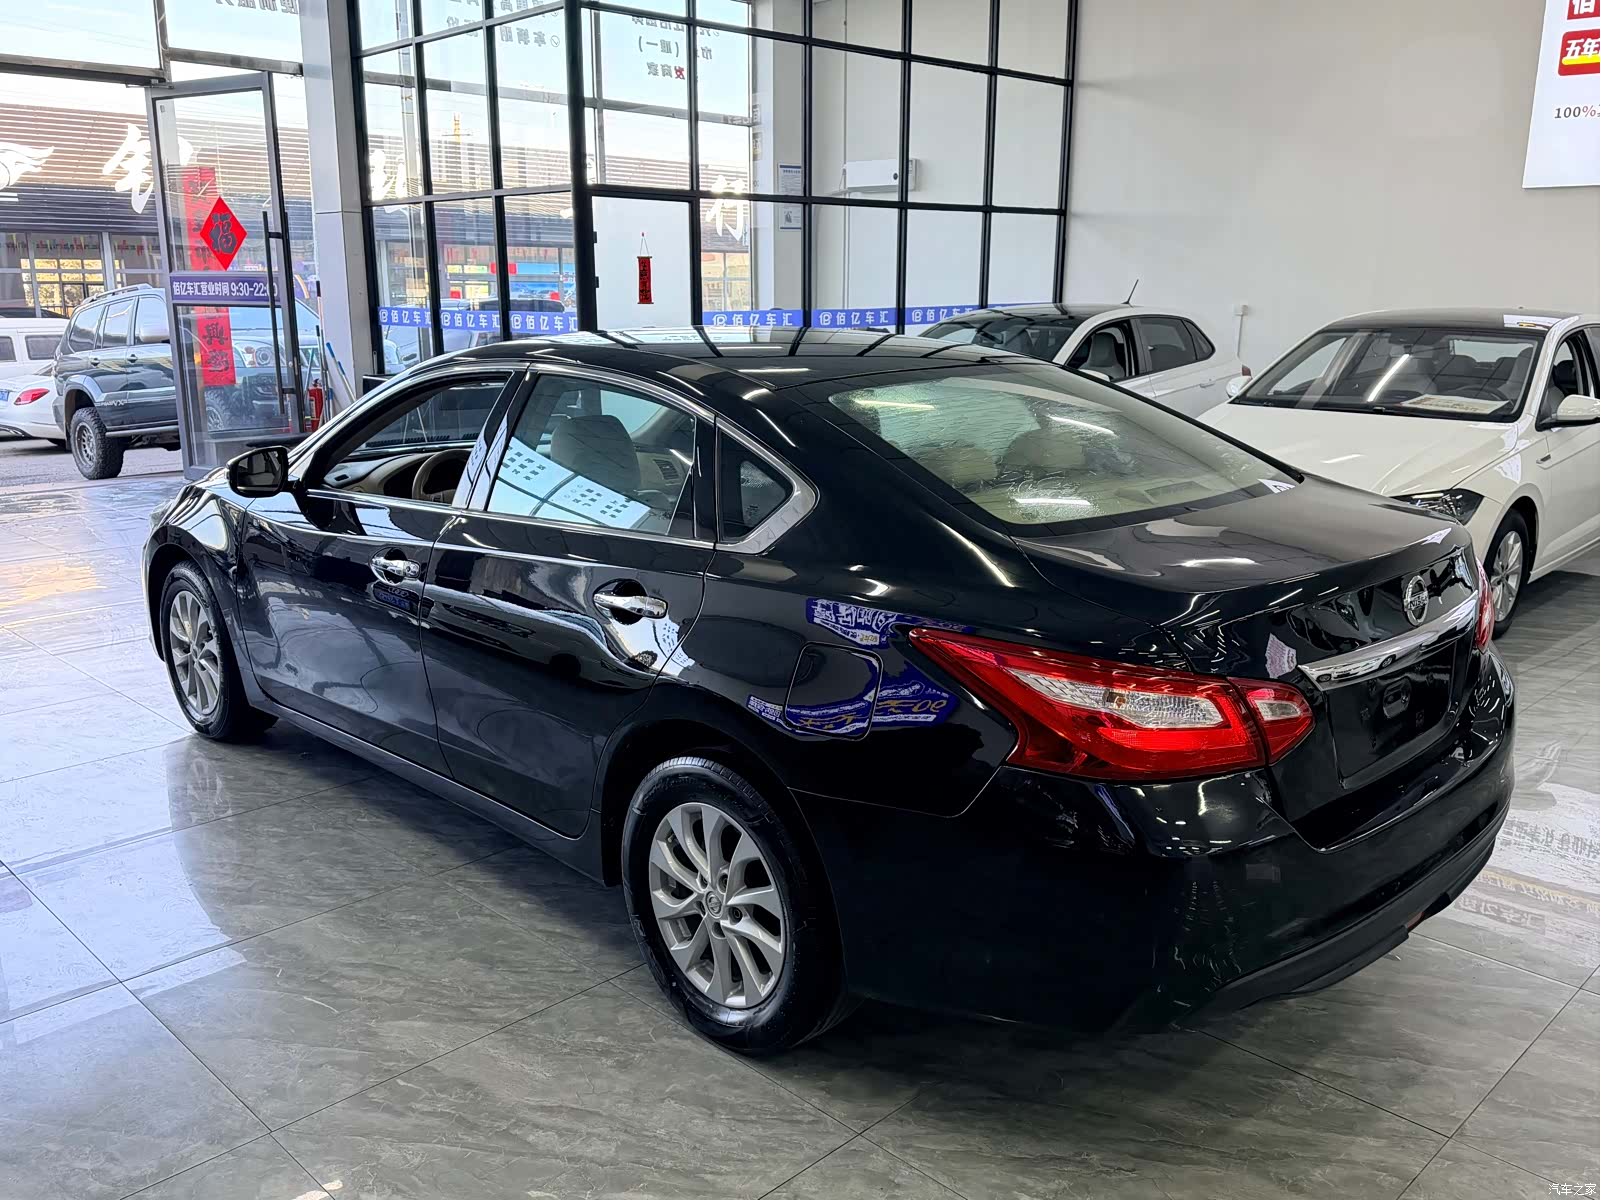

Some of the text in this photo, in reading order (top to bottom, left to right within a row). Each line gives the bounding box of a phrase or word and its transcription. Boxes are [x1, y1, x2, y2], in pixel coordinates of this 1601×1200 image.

[1554, 105, 1601, 119] 100%
[209, 212, 237, 255] 福
[173, 281, 277, 297] 佰亿车汇营业时间 9:30-22:0
[526, 314, 578, 332] 佰亿车汇
[732, 313, 793, 327] 佰亿车汇
[836, 310, 889, 326] 佰亿车汇
